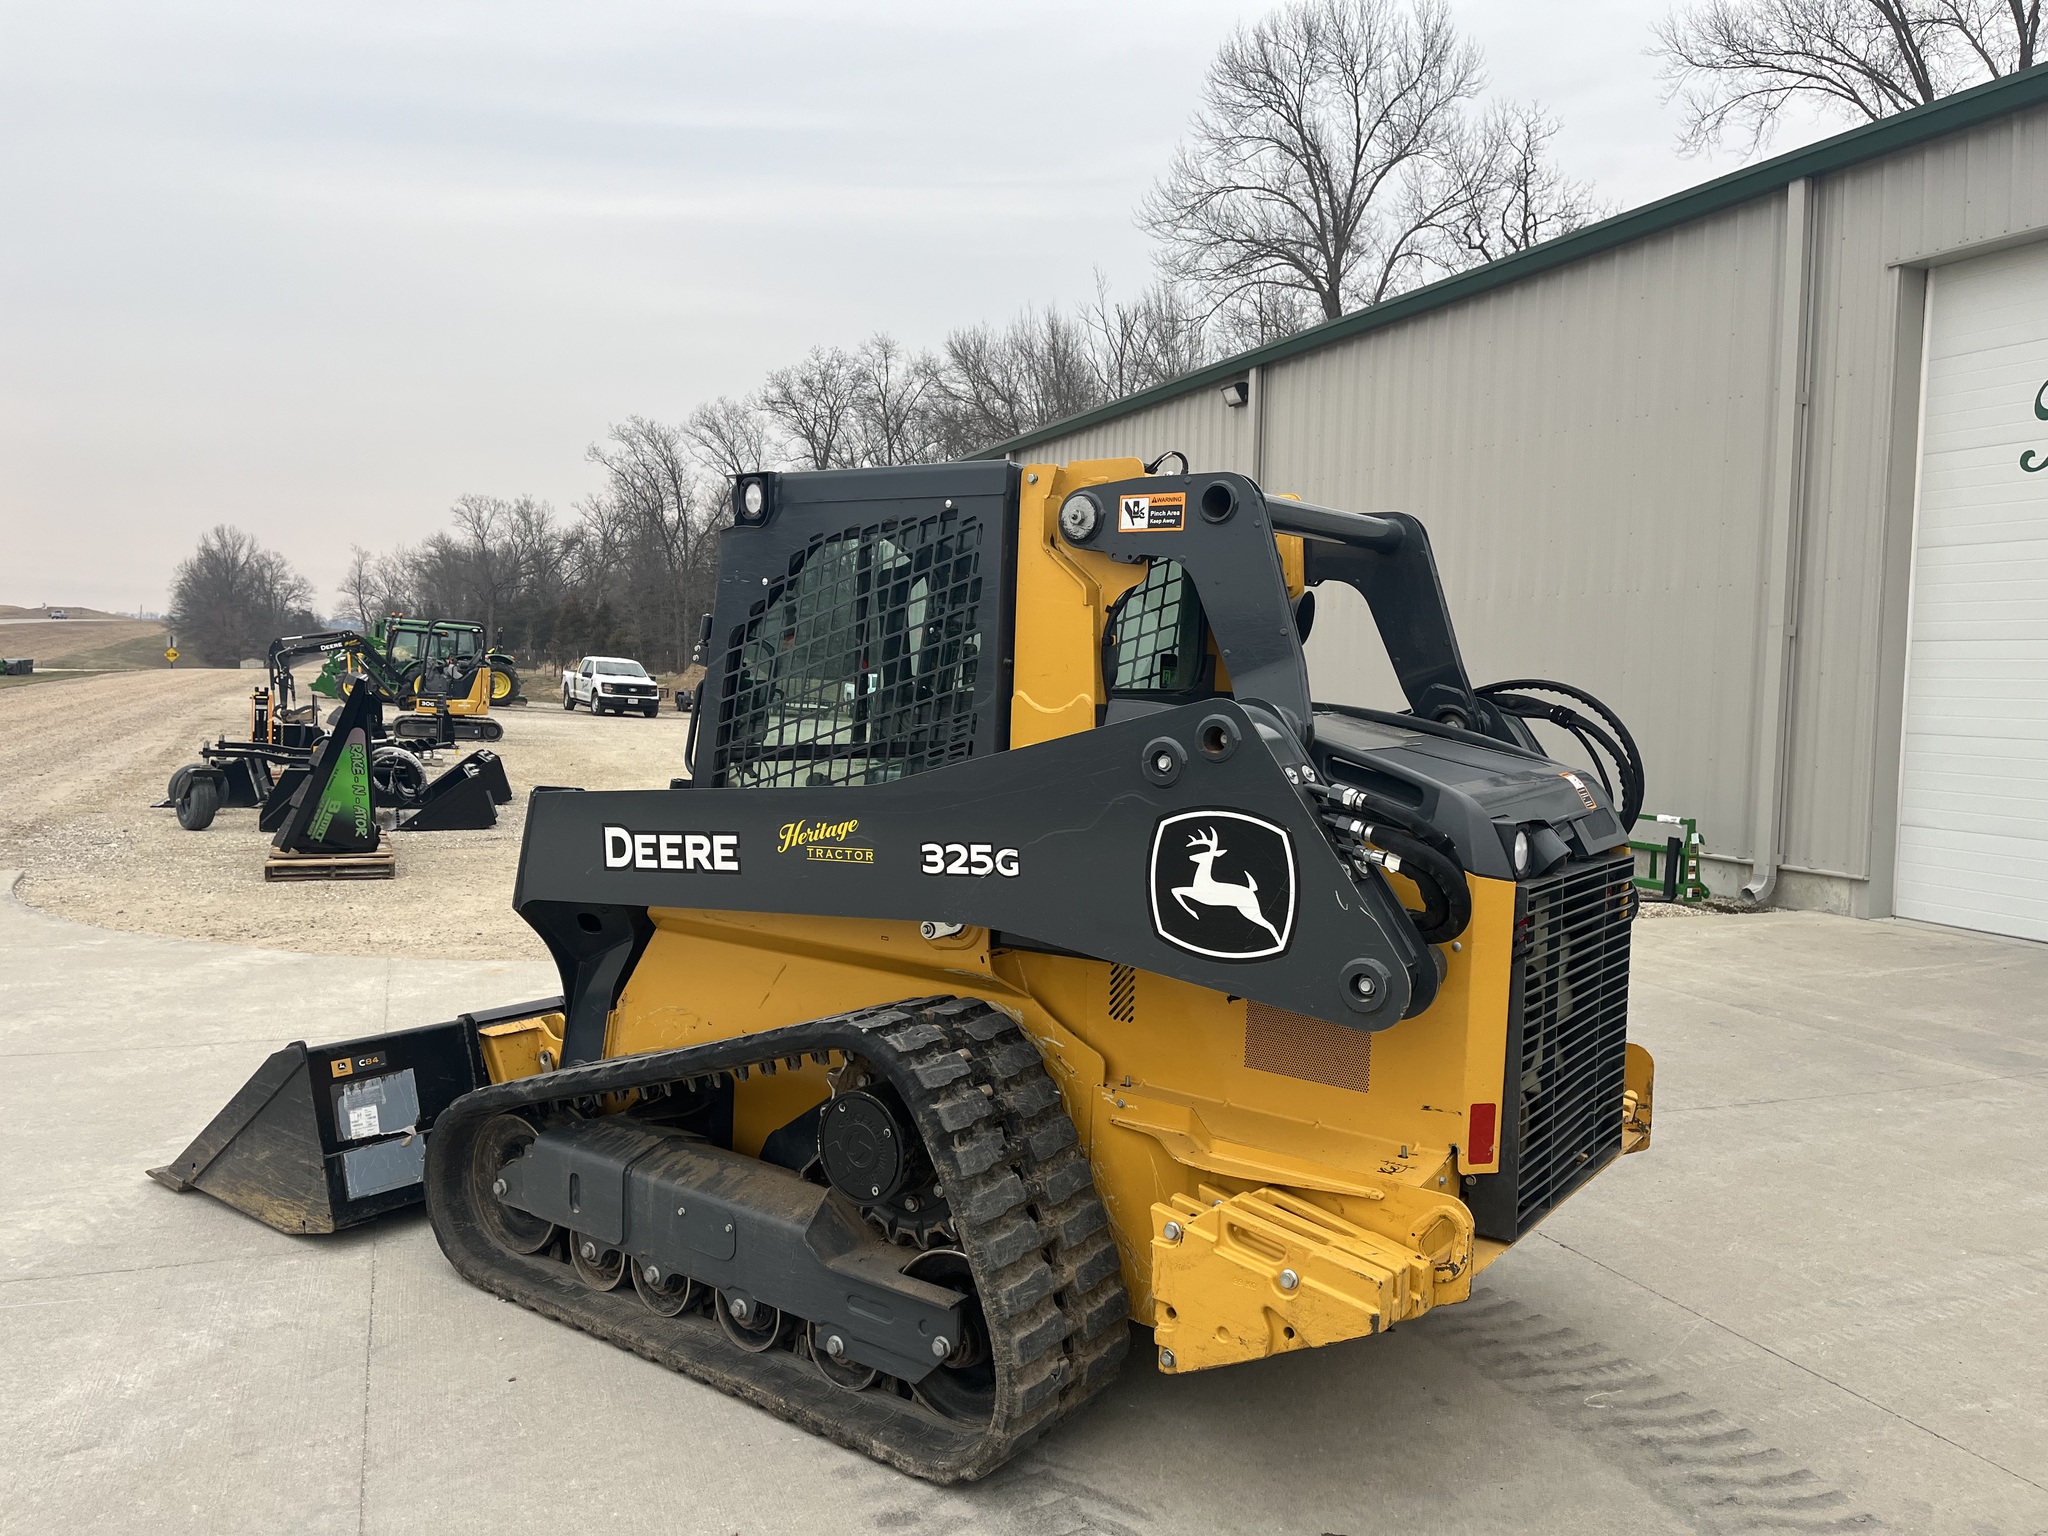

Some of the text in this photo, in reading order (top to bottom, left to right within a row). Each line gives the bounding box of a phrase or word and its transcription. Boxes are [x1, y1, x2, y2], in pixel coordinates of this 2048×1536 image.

[320, 642, 343, 651] DEERE
[777, 819, 859, 853] Heritage
[603, 826, 739, 871] DEERE
[806, 848, 874, 861] TRACTOR
[921, 843, 1019, 877] 325G
[358, 1056, 380, 1067] C84
